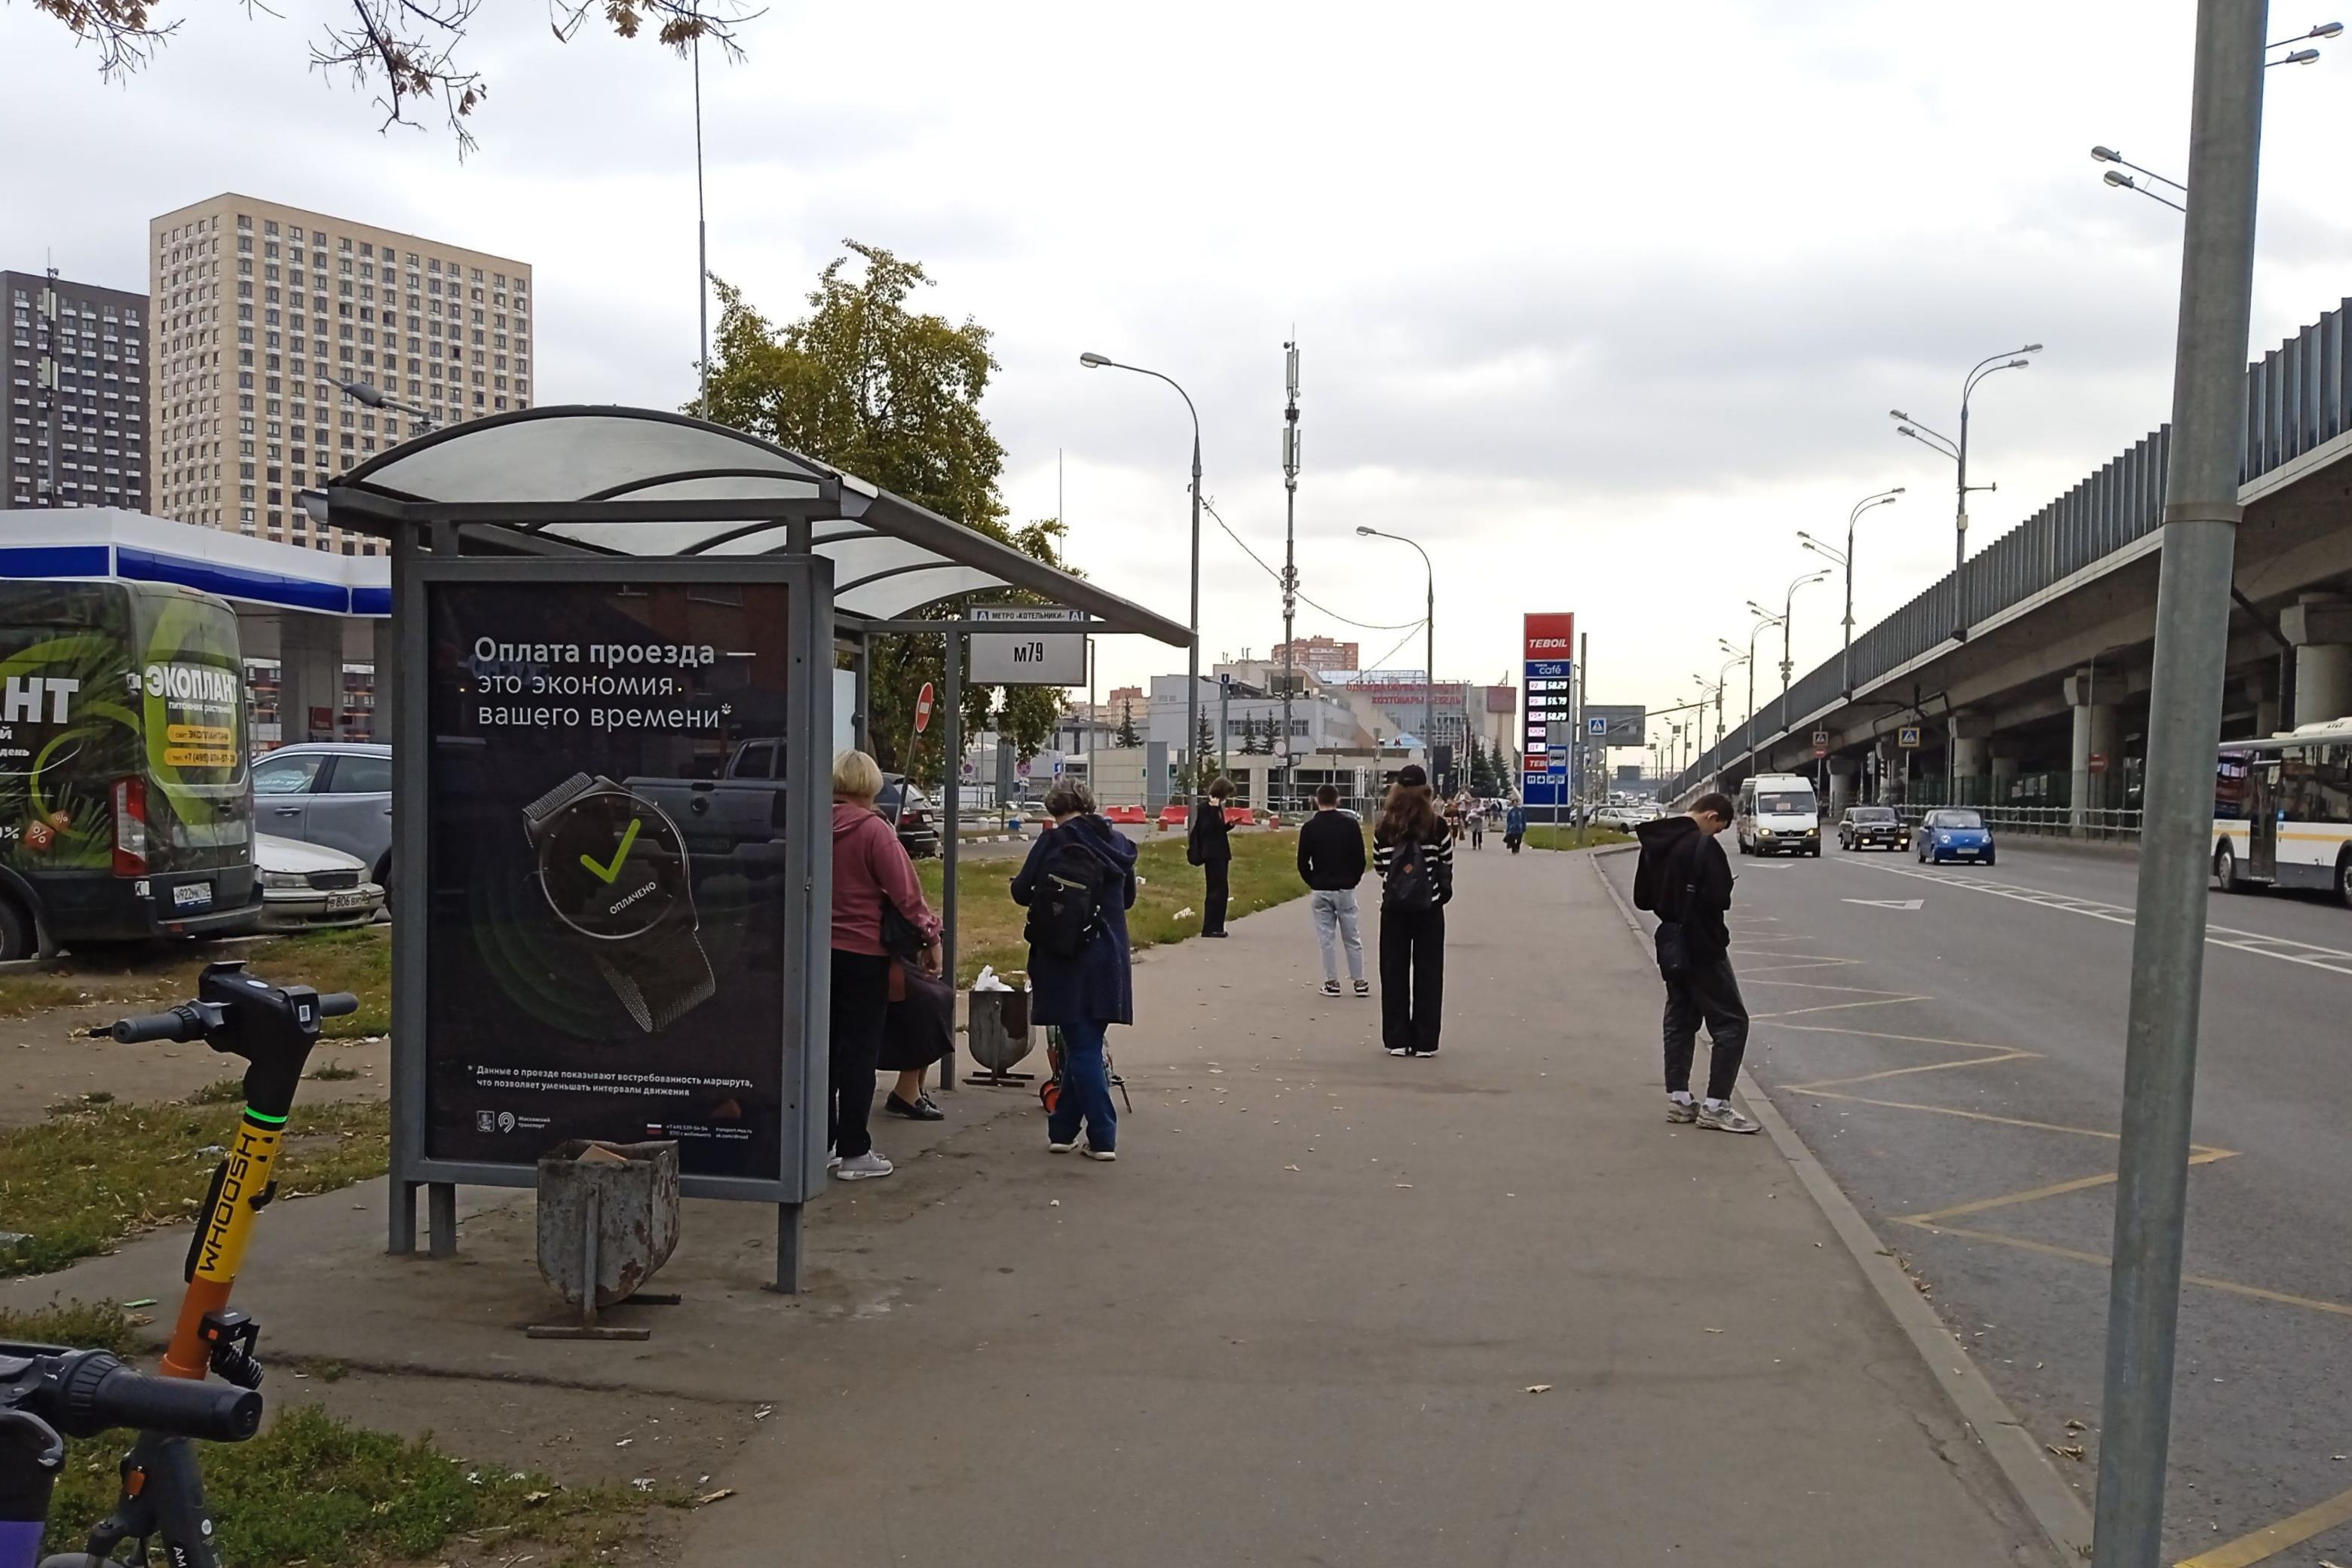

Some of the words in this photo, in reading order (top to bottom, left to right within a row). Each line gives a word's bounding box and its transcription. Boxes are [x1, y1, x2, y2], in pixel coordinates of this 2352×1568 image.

[474, 636, 580, 663] Оплата
[590, 645, 715, 669] проезда
[1529, 639, 1568, 648] TEBOIL
[1539, 664, 1562, 675] café
[145, 664, 237, 703] ЭКОПЛАНТ
[478, 675, 522, 694] это
[532, 675, 673, 696] экономия
[0, 676, 80, 724] НТ
[479, 706, 580, 726] вашего
[610, 881, 656, 914] ОПЛАЧЕНО
[476, 1065, 511, 1075] Данные
[521, 1068, 559, 1079] проезде
[561, 1070, 616, 1080] показывают
[617, 1073, 701, 1084] востребованность
[703, 1077, 753, 1088] маршрута,
[494, 1080, 540, 1089] позволяет
[541, 1082, 591, 1091] уменьшать
[593, 1085, 642, 1095] интервалы
[643, 1086, 690, 1096] движения
[198, 1132, 257, 1272] WHOOSH
